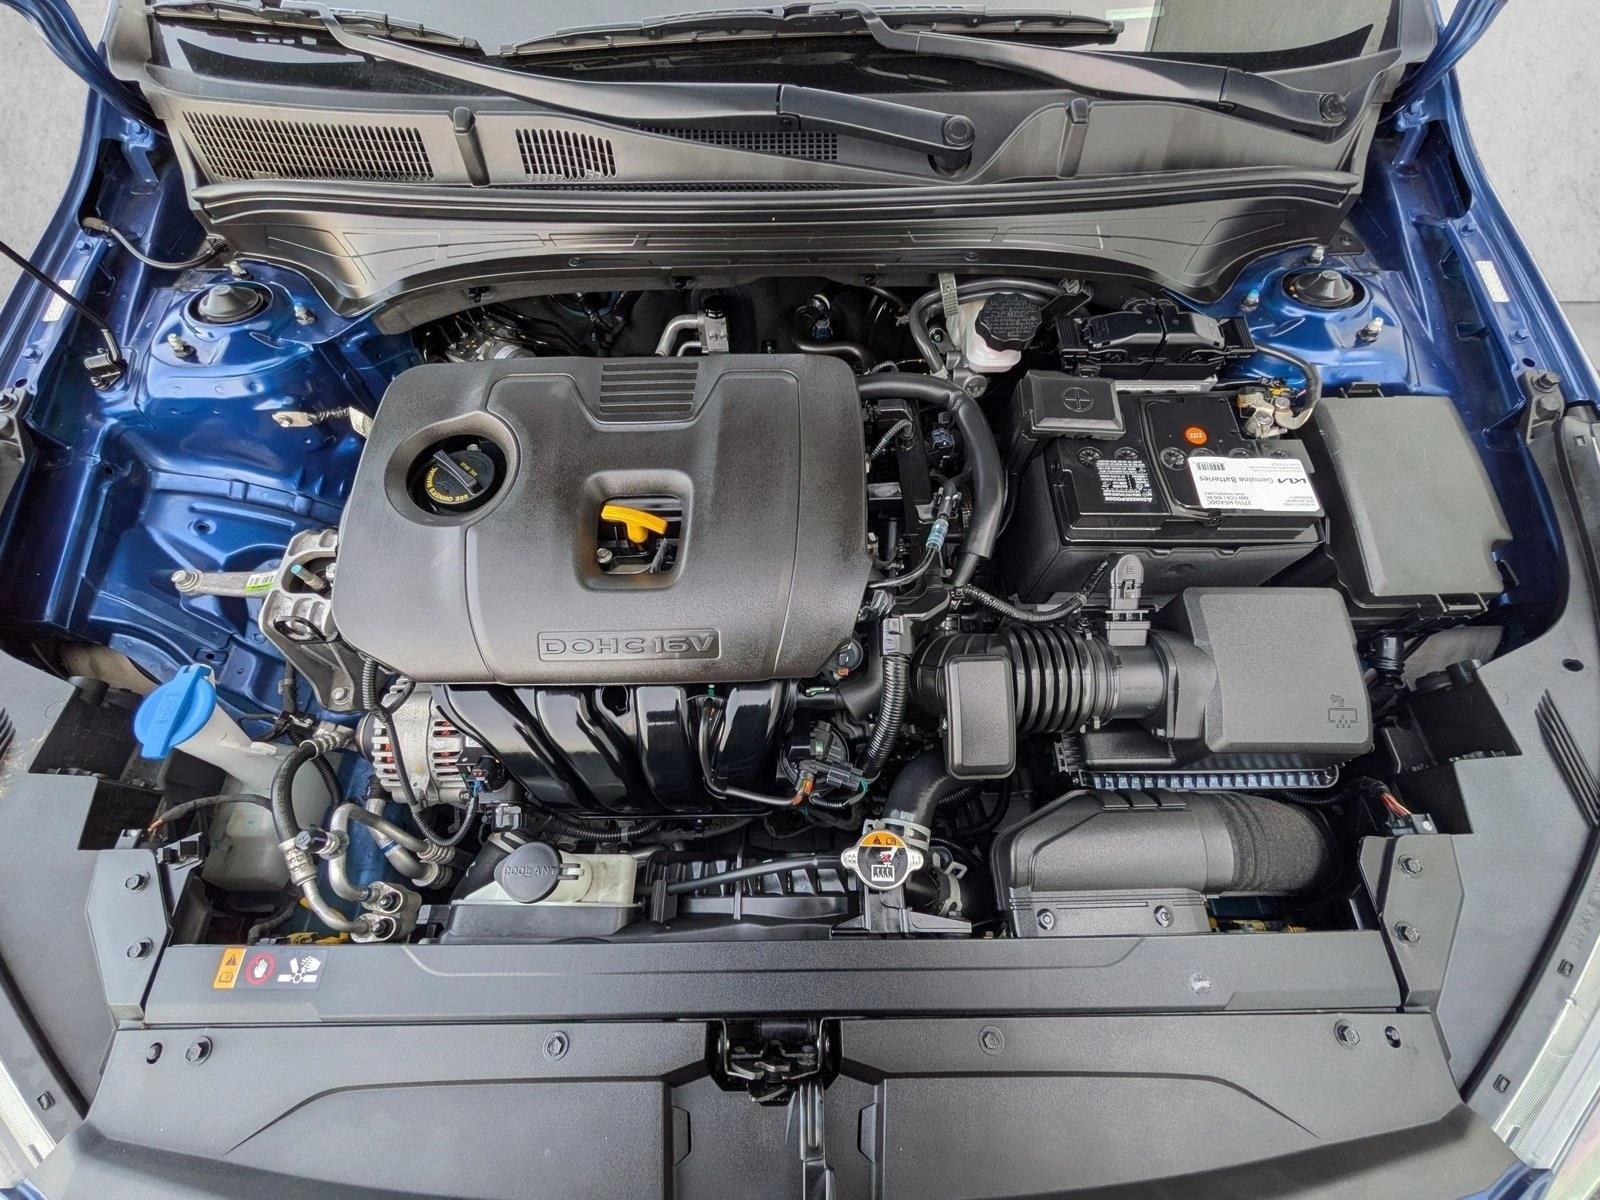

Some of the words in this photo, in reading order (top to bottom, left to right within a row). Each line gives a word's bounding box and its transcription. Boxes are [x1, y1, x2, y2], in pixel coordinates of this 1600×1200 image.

[1199, 476, 1237, 484] Batteries
[454, 494, 469, 502] SEE
[541, 638, 645, 654] DOHC
[653, 636, 715, 653] 16V
[504, 865, 558, 877] COOLANT
